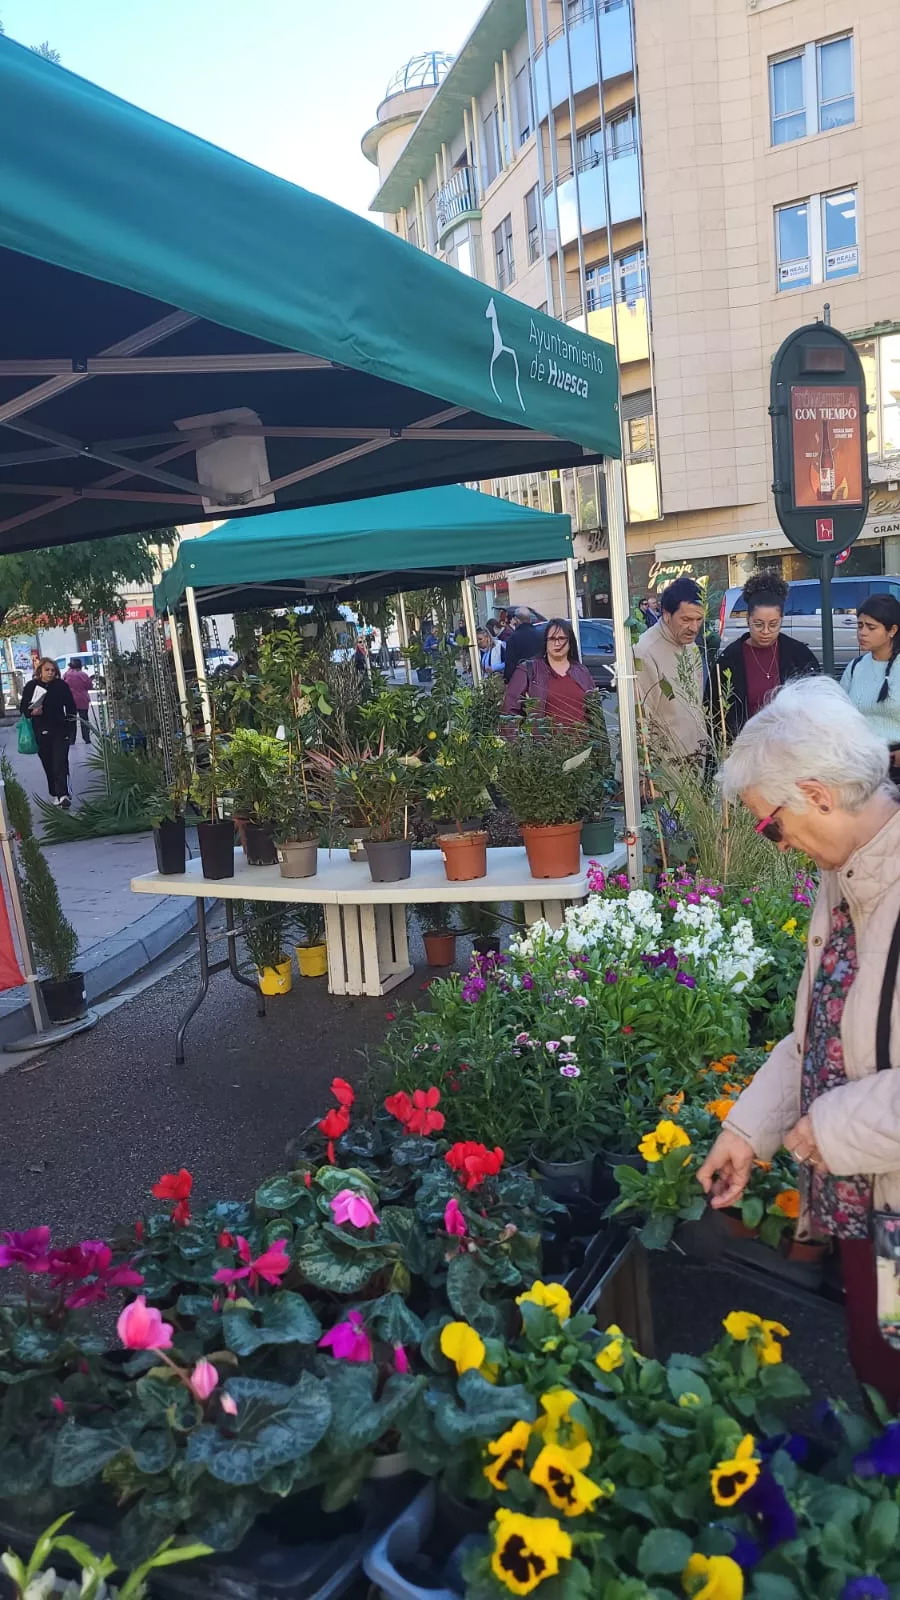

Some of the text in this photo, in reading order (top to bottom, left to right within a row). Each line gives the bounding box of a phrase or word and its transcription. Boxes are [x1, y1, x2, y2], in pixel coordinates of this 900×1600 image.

[529, 317, 603, 374] Ayuntamiento
[530, 356, 589, 399] de Huesca
[795, 407, 857, 420] CON TIEMPO
[648, 561, 694, 589] Granja
